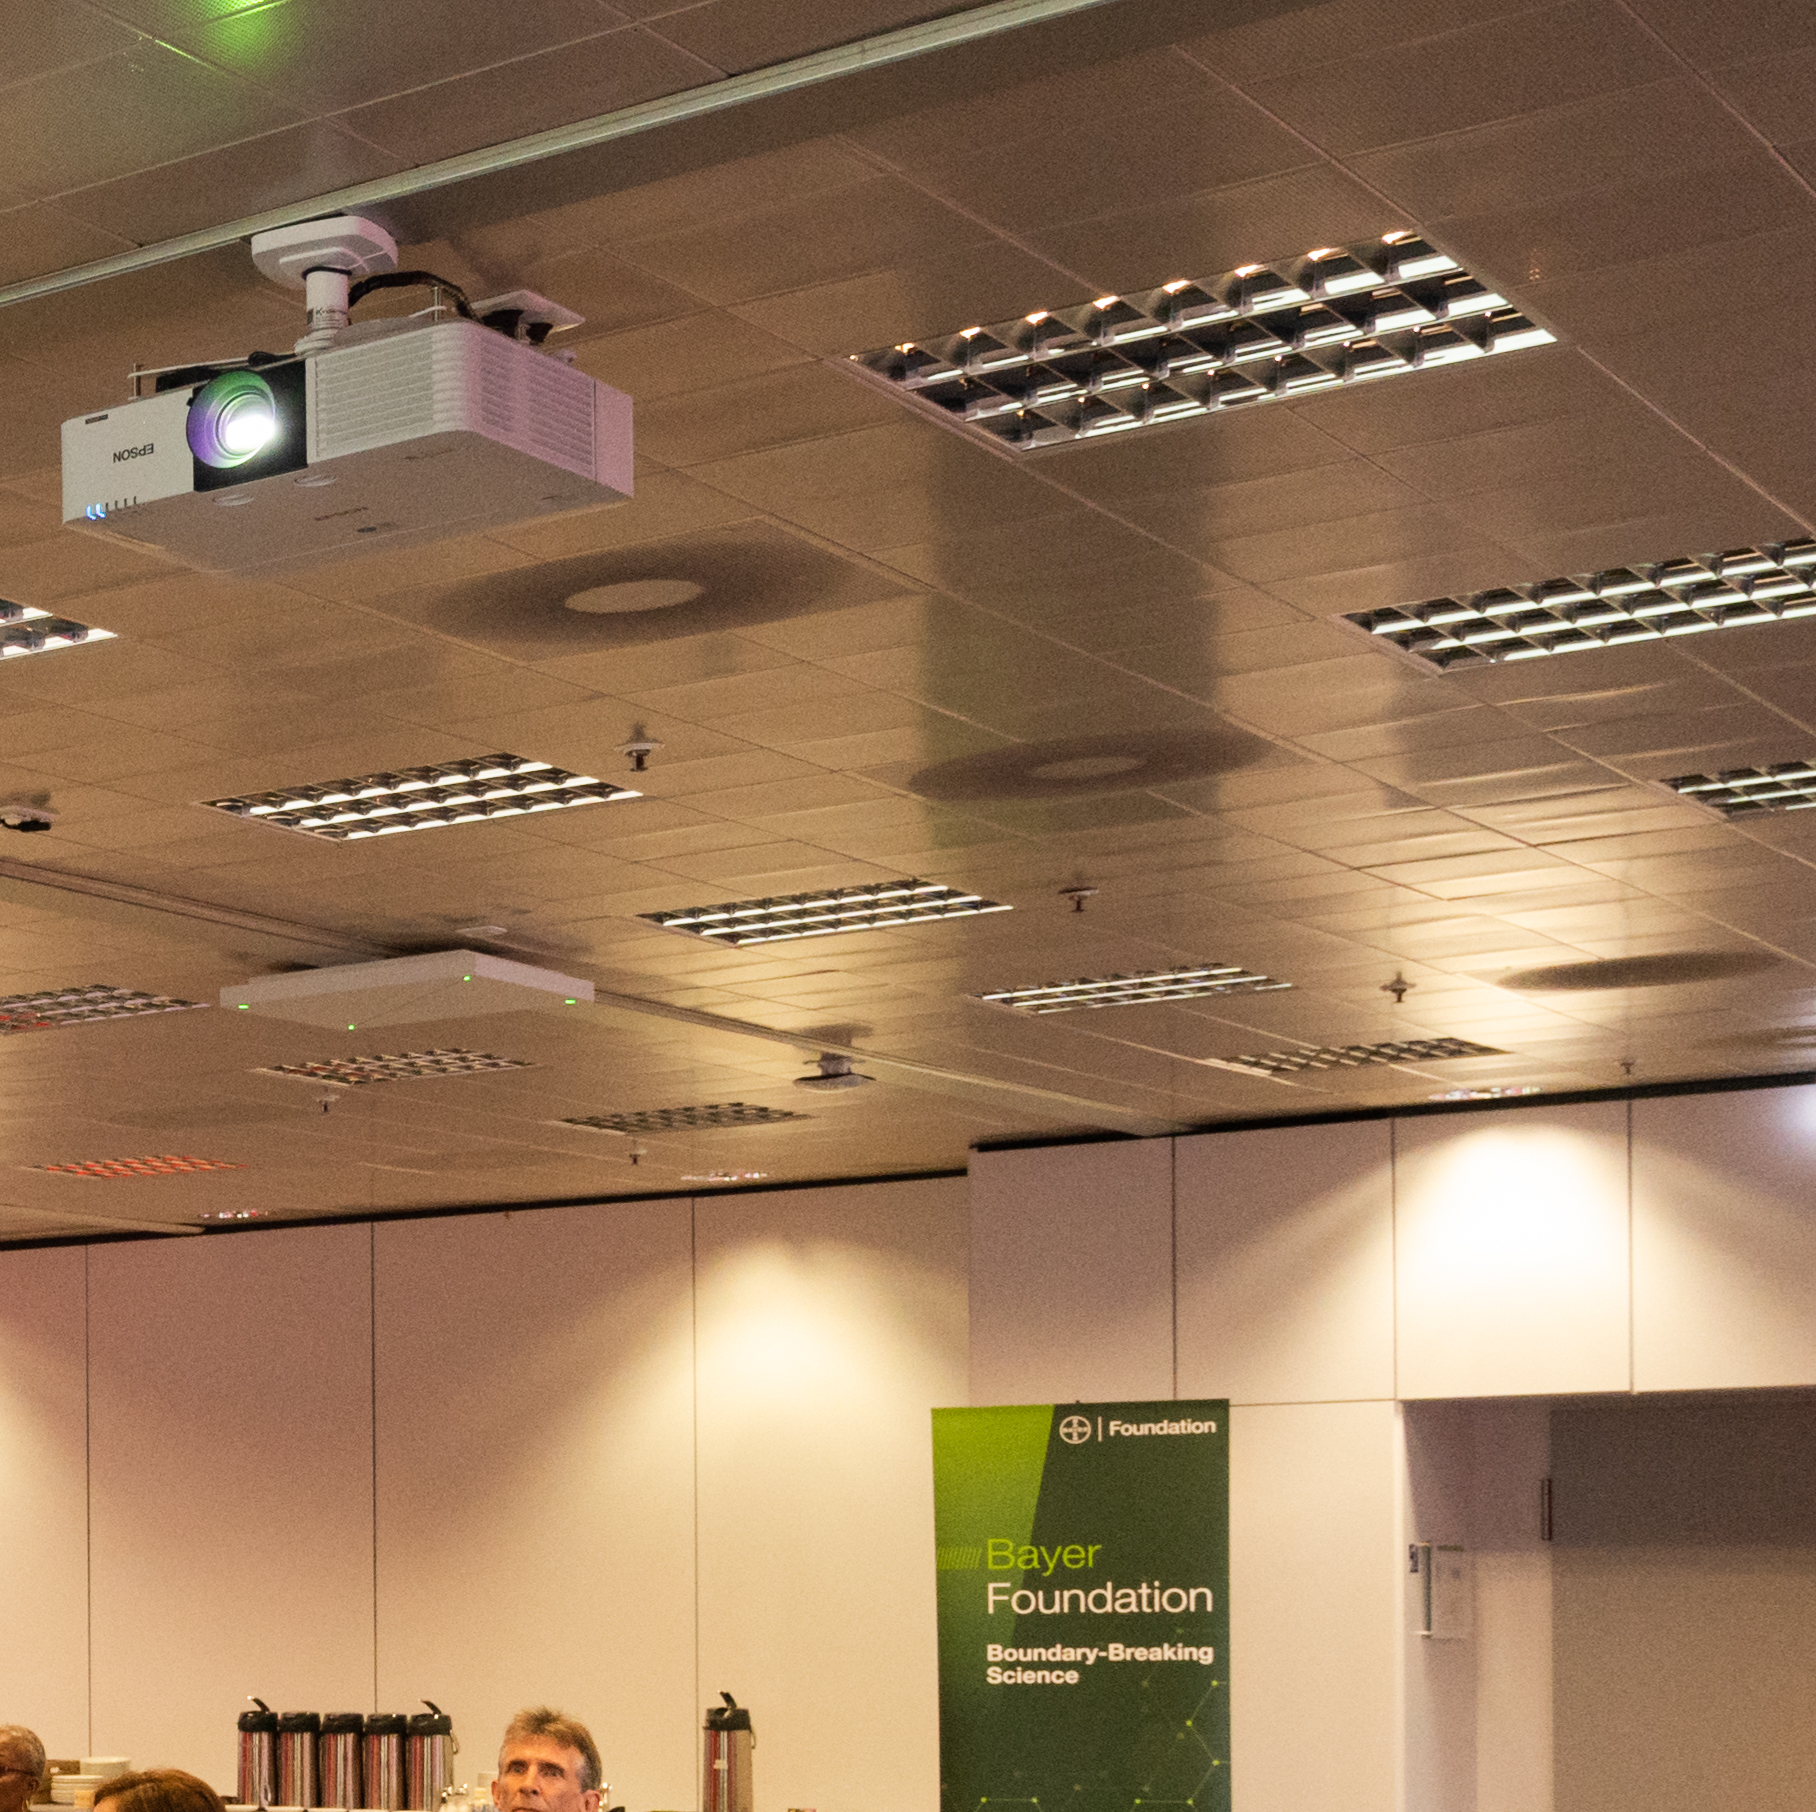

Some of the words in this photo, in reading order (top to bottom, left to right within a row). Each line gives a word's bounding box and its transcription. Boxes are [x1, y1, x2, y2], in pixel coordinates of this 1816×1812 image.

[112, 443, 155, 463] EPSON
[1109, 1418, 1217, 1437] Foundation
[986, 1538, 1102, 1577] Bayer
[986, 1580, 1214, 1615] Foundation
[985, 1643, 1215, 1665] Boundary-Breaking
[985, 1666, 1080, 1685] Science
